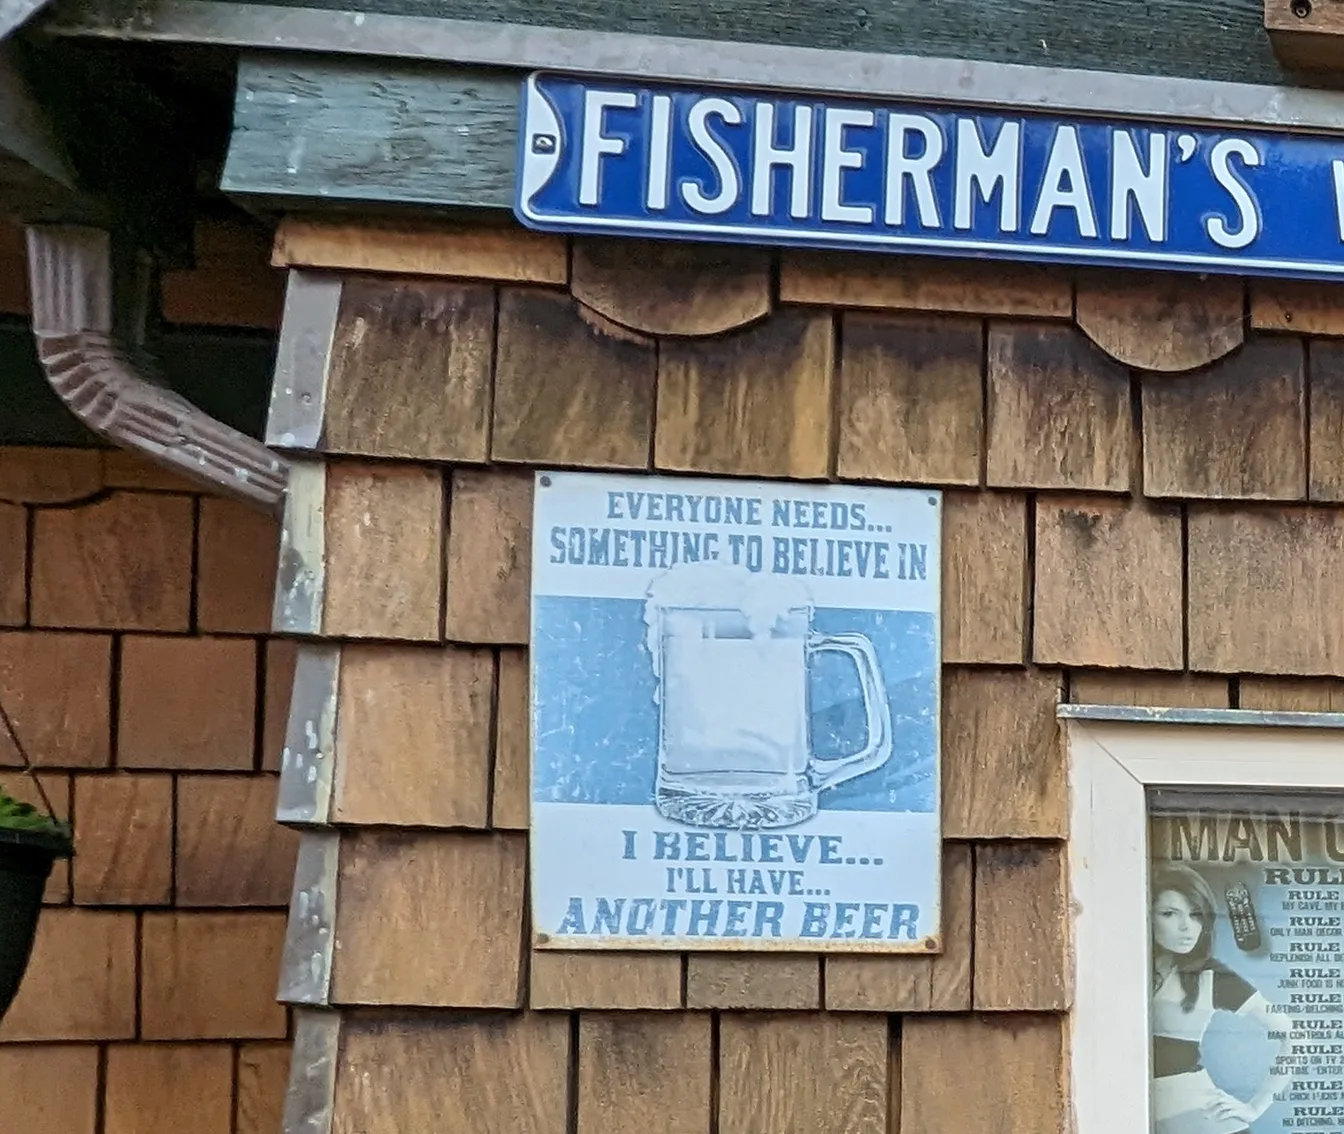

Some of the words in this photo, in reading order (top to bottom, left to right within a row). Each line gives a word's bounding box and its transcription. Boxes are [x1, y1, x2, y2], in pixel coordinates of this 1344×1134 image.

[580, 91, 1264, 250] FISHERMAN'S
[606, 492, 762, 526] EVERYONE
[772, 500, 892, 533] NEEDS...
[550, 526, 719, 567] SOMETHING
[729, 534, 761, 572] TO
[772, 536, 890, 579] BELIEVE
[897, 543, 928, 580] IN
[1170, 812, 1302, 862] MAN
[622, 830, 638, 860] I
[653, 830, 884, 865] BELIEVE...
[666, 867, 717, 893] I'LL
[727, 868, 831, 896] HAVE...
[1288, 890, 1339, 900] RULE
[556, 897, 796, 938] ANOTHER
[802, 902, 919, 939] BEER
[1290, 917, 1341, 926] RULE
[1290, 942, 1341, 952] RULE
[1290, 969, 1341, 978] RULE
[1290, 994, 1341, 1003] RULE
[1292, 1020, 1343, 1029] RULE
[1292, 1045, 1342, 1054] RULE
[1292, 1081, 1343, 1090] RULE
[1294, 1106, 1344, 1116] RULE
